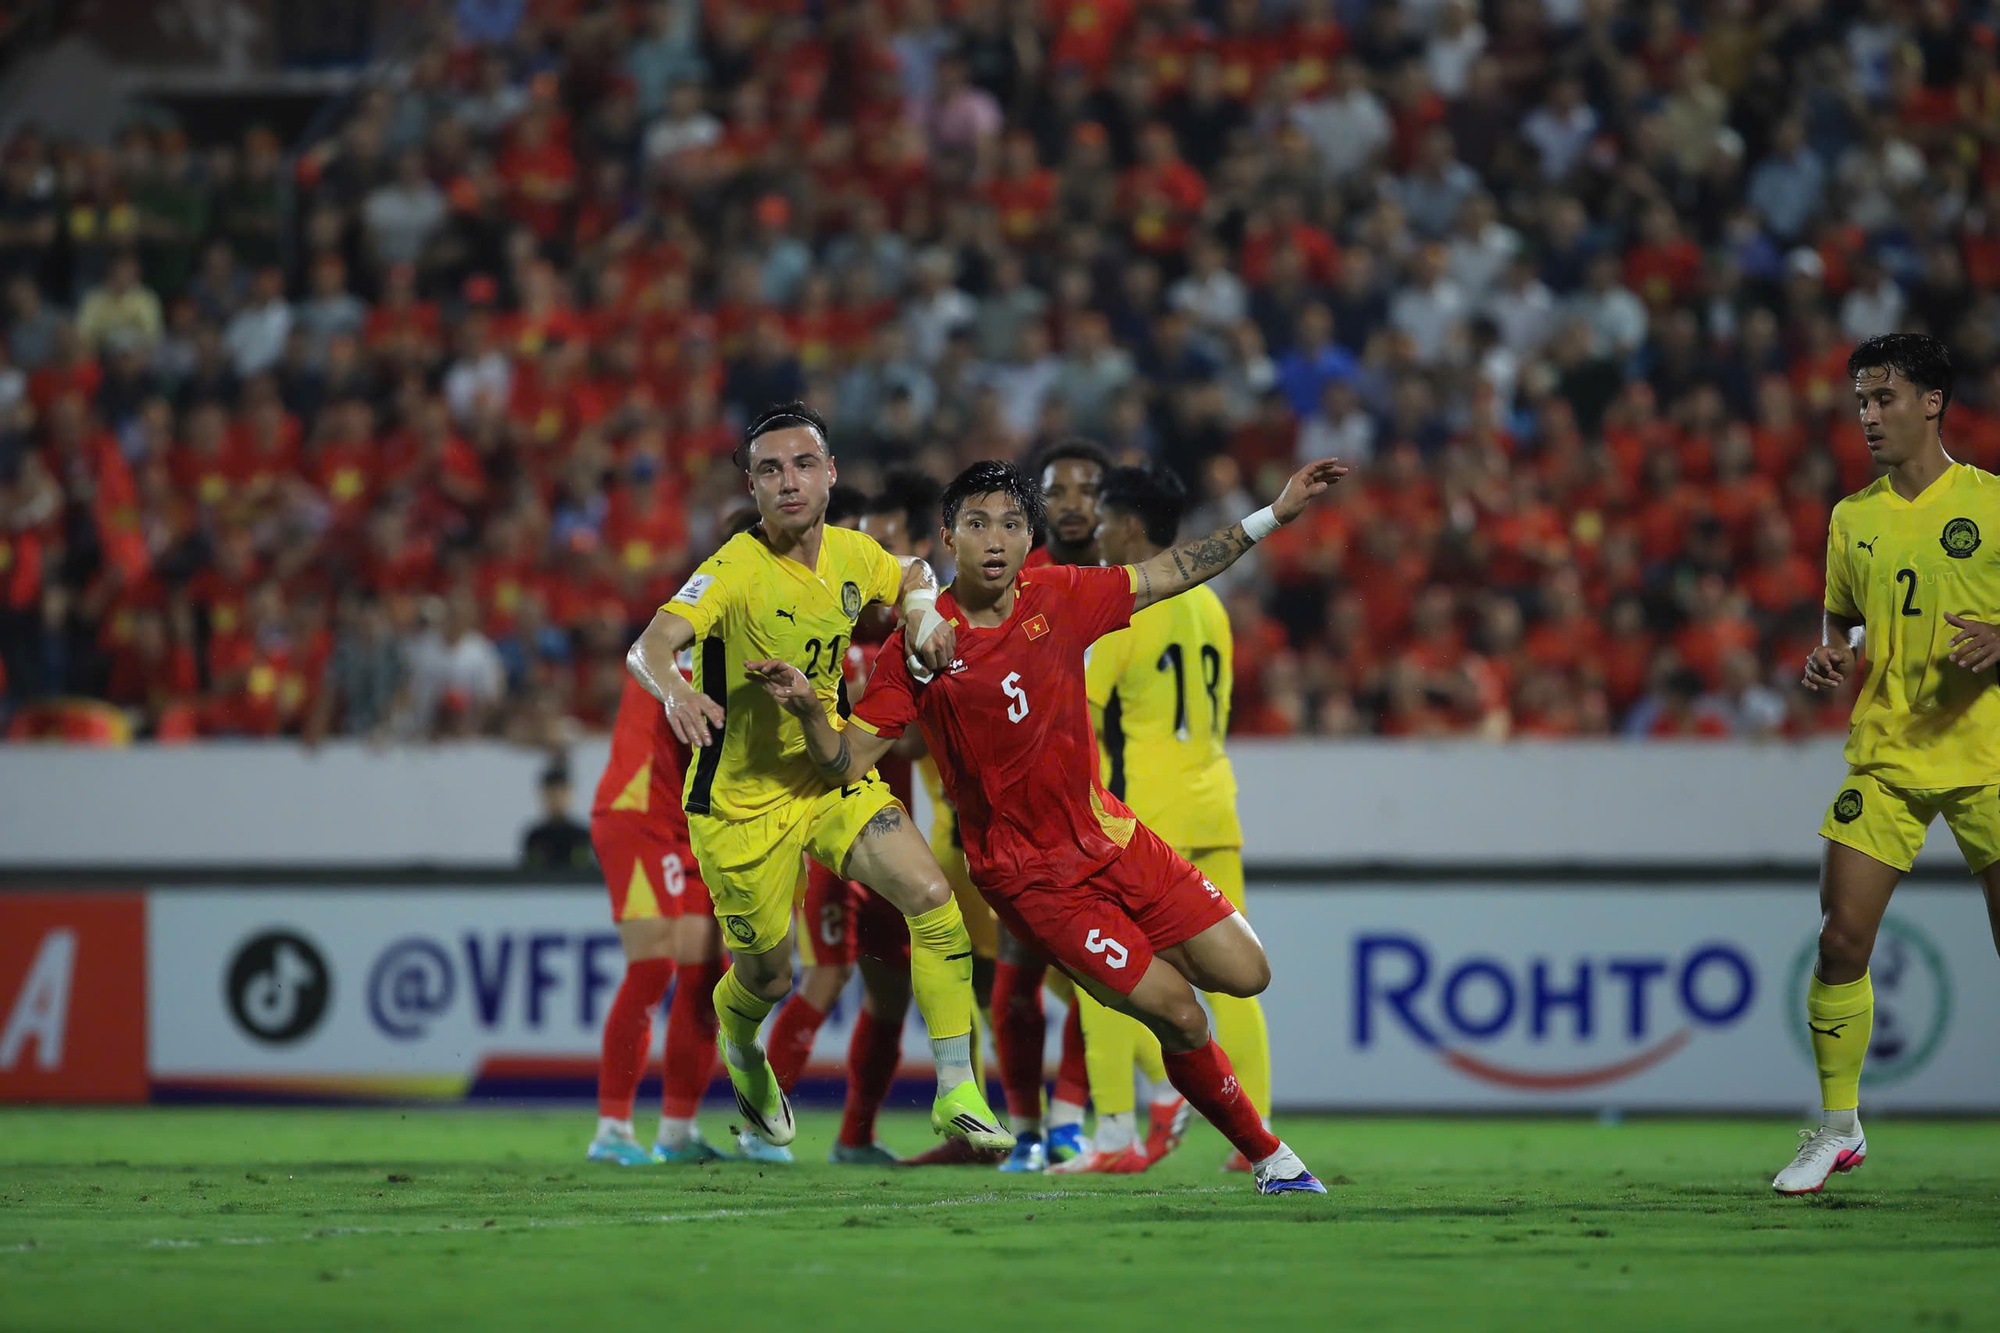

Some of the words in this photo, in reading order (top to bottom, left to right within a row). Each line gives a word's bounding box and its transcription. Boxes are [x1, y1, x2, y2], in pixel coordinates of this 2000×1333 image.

[1896, 568, 1922, 616] 2
[805, 634, 840, 679] 21
[1001, 671, 1029, 724] 5
[1085, 929, 1128, 969] 5
